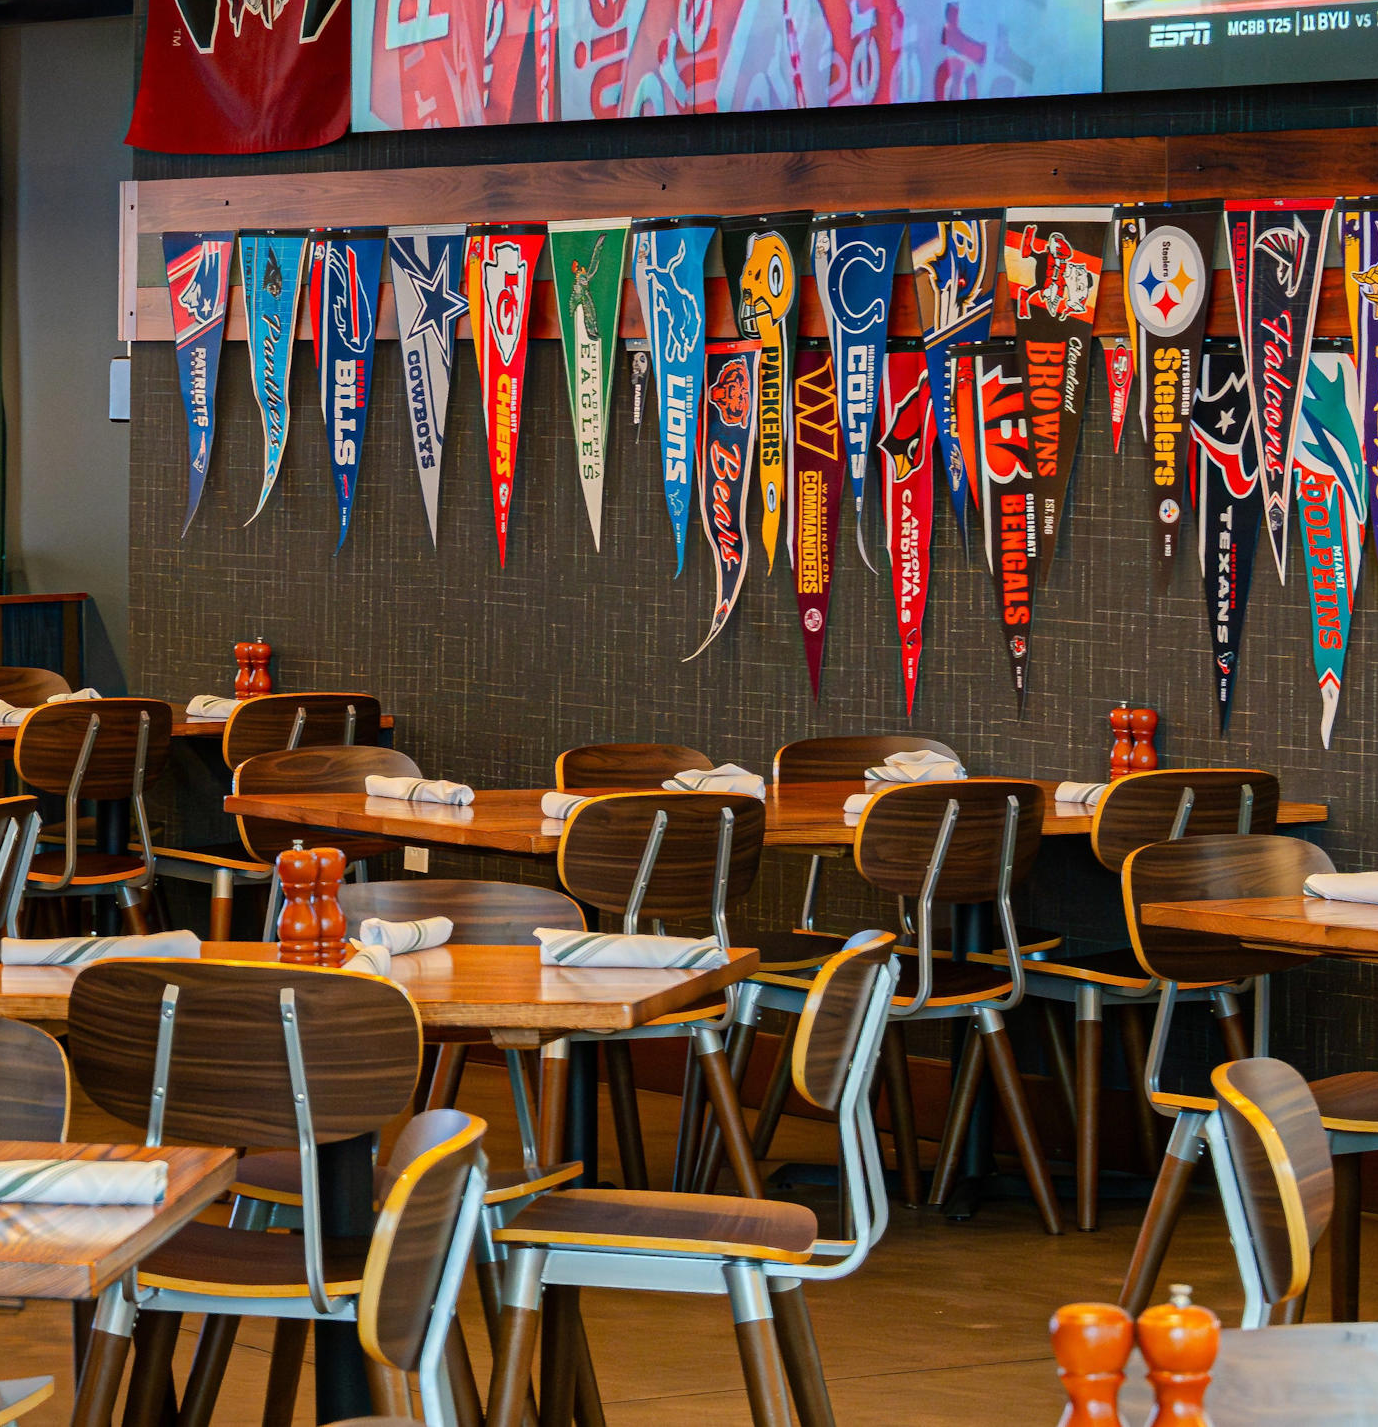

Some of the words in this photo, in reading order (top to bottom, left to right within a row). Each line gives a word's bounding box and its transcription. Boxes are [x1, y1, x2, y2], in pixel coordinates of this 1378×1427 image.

[1149, 21, 1211, 48] ESPN
[1227, 19, 1266, 37] MCBB
[1267, 17, 1291, 34] T25
[1318, 10, 1350, 30] BYU
[1355, 14, 1372, 28] vs
[194, 347, 208, 427] PATRIOTS
[334, 359, 357, 466] BILLS
[407, 349, 436, 470] COWBOYS
[495, 373, 512, 478] CHIEFS
[581, 343, 594, 481] EAGLES
[591, 343, 601, 480] PHILADELPHIA
[633, 383, 642, 425] RAIDERS
[665, 373, 687, 485] LIONS
[685, 375, 694, 420] DETROIT
[759, 346, 782, 468] PACKERS
[846, 345, 868, 480] COLTS
[1025, 340, 1068, 478] BROWNS
[1062, 336, 1084, 414] Cleveland
[1153, 347, 1183, 487] Steelers
[1181, 348, 1190, 416] PITTSBURGH
[1259, 310, 1293, 476] Falcons
[710, 439, 742, 572] Bears
[801, 470, 823, 594] COMMANDERS
[822, 482, 830, 584] WASHINGTON
[900, 488, 912, 624] CARDINALS
[910, 516, 921, 598] ARIZONA
[1000, 493, 1030, 626] BENGALS
[1025, 493, 1036, 558] CINCINNATI
[1302, 478, 1342, 650] DOLPHINS
[1215, 505, 1233, 644] TEXANS
[1332, 545, 1344, 589] MIAMI
